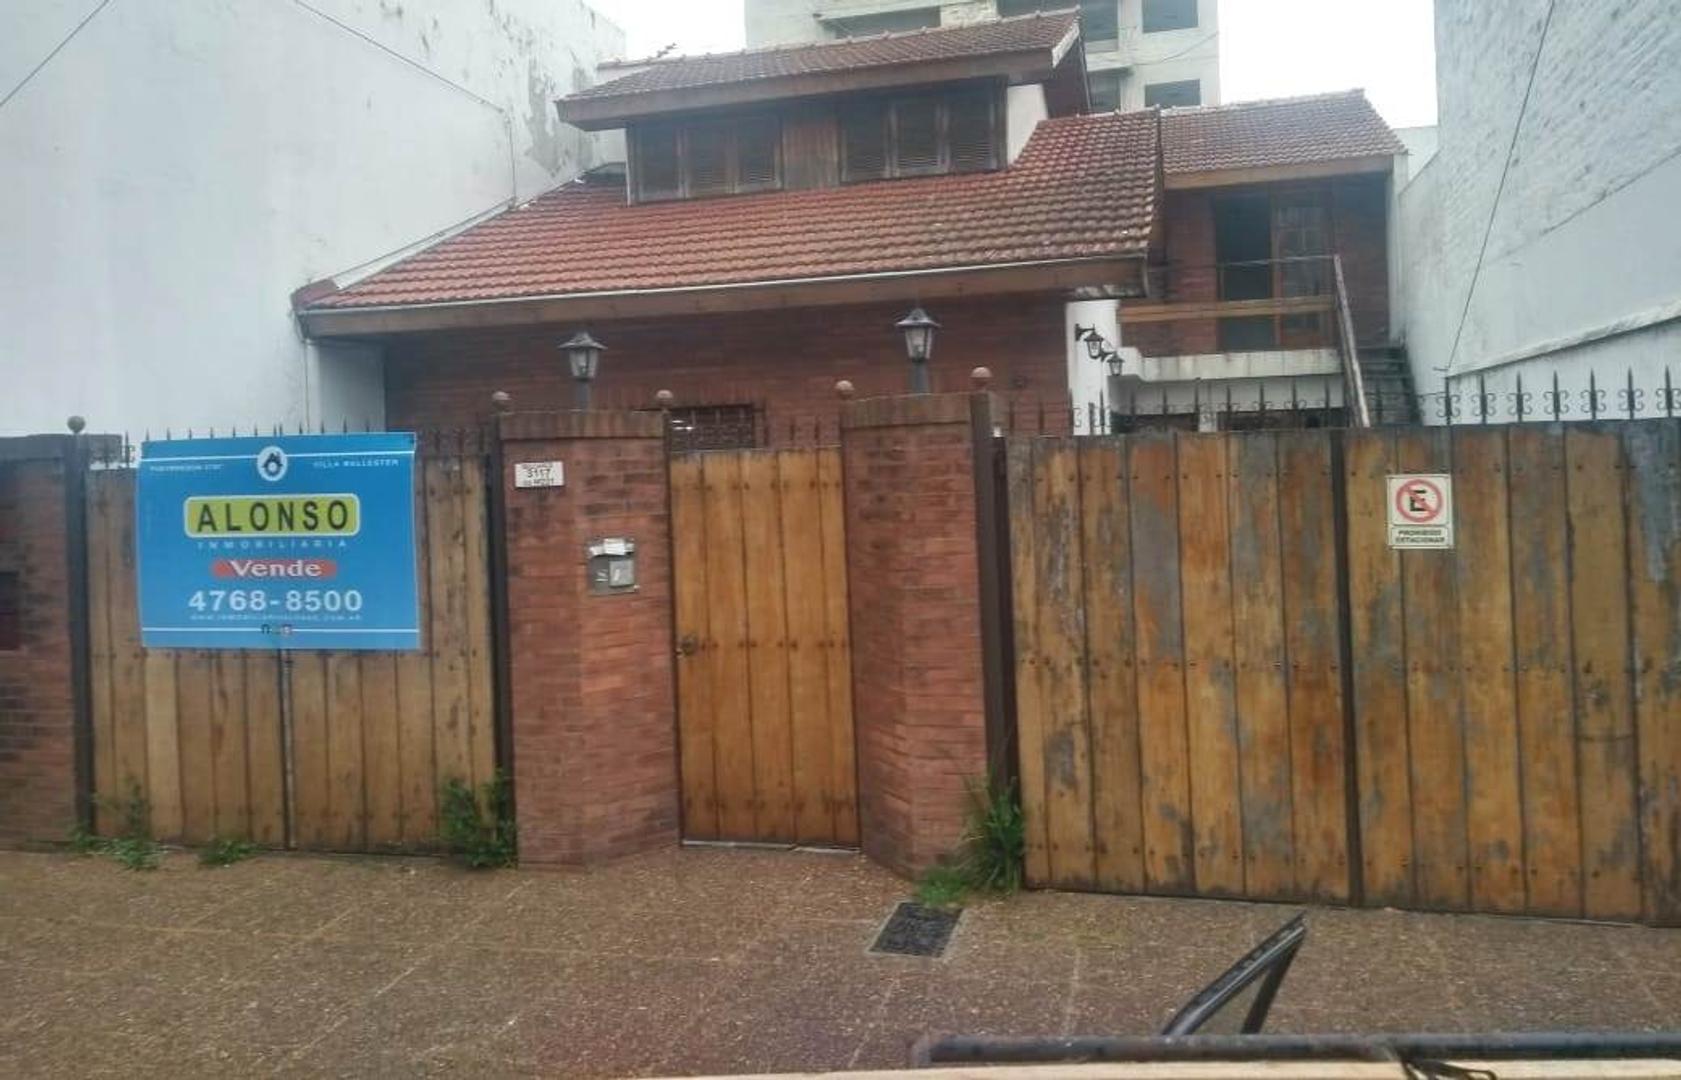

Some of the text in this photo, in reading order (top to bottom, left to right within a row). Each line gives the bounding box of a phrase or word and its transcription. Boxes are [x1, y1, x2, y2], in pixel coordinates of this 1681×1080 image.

[197, 500, 349, 532] ALONSO
[197, 540, 347, 549] INMOBILIARIA
[230, 560, 323, 577] Vende
[188, 590, 363, 612] 4768-8500
